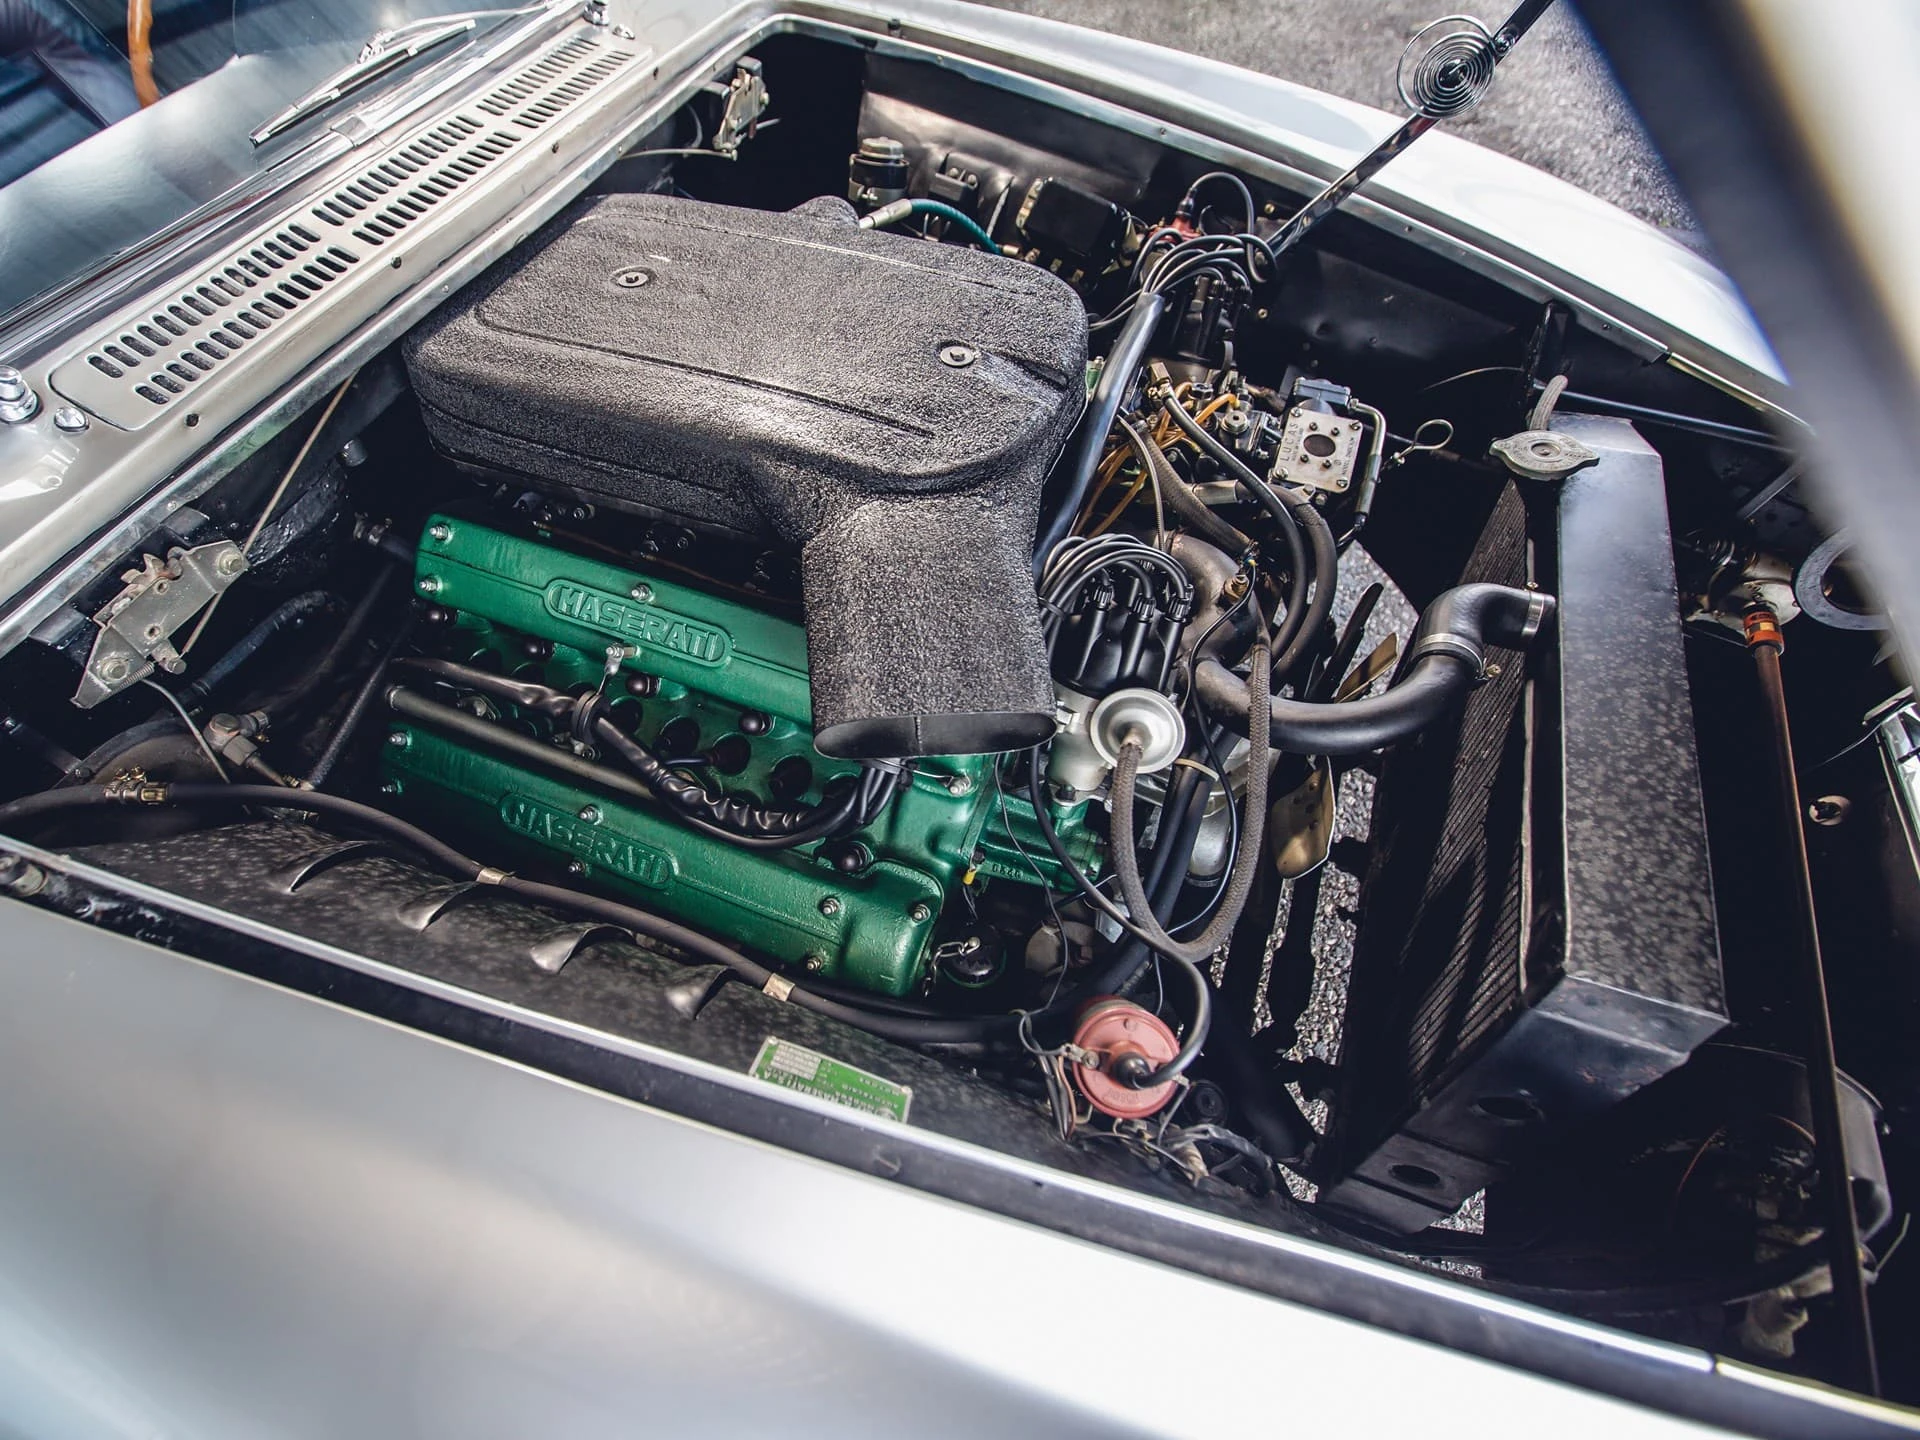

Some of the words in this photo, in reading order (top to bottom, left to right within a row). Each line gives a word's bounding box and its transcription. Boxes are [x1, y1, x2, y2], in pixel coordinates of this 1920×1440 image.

[1280, 423, 1299, 462] LUCAS
[557, 586, 719, 661] MASERATI
[508, 801, 668, 884] MASERATI
